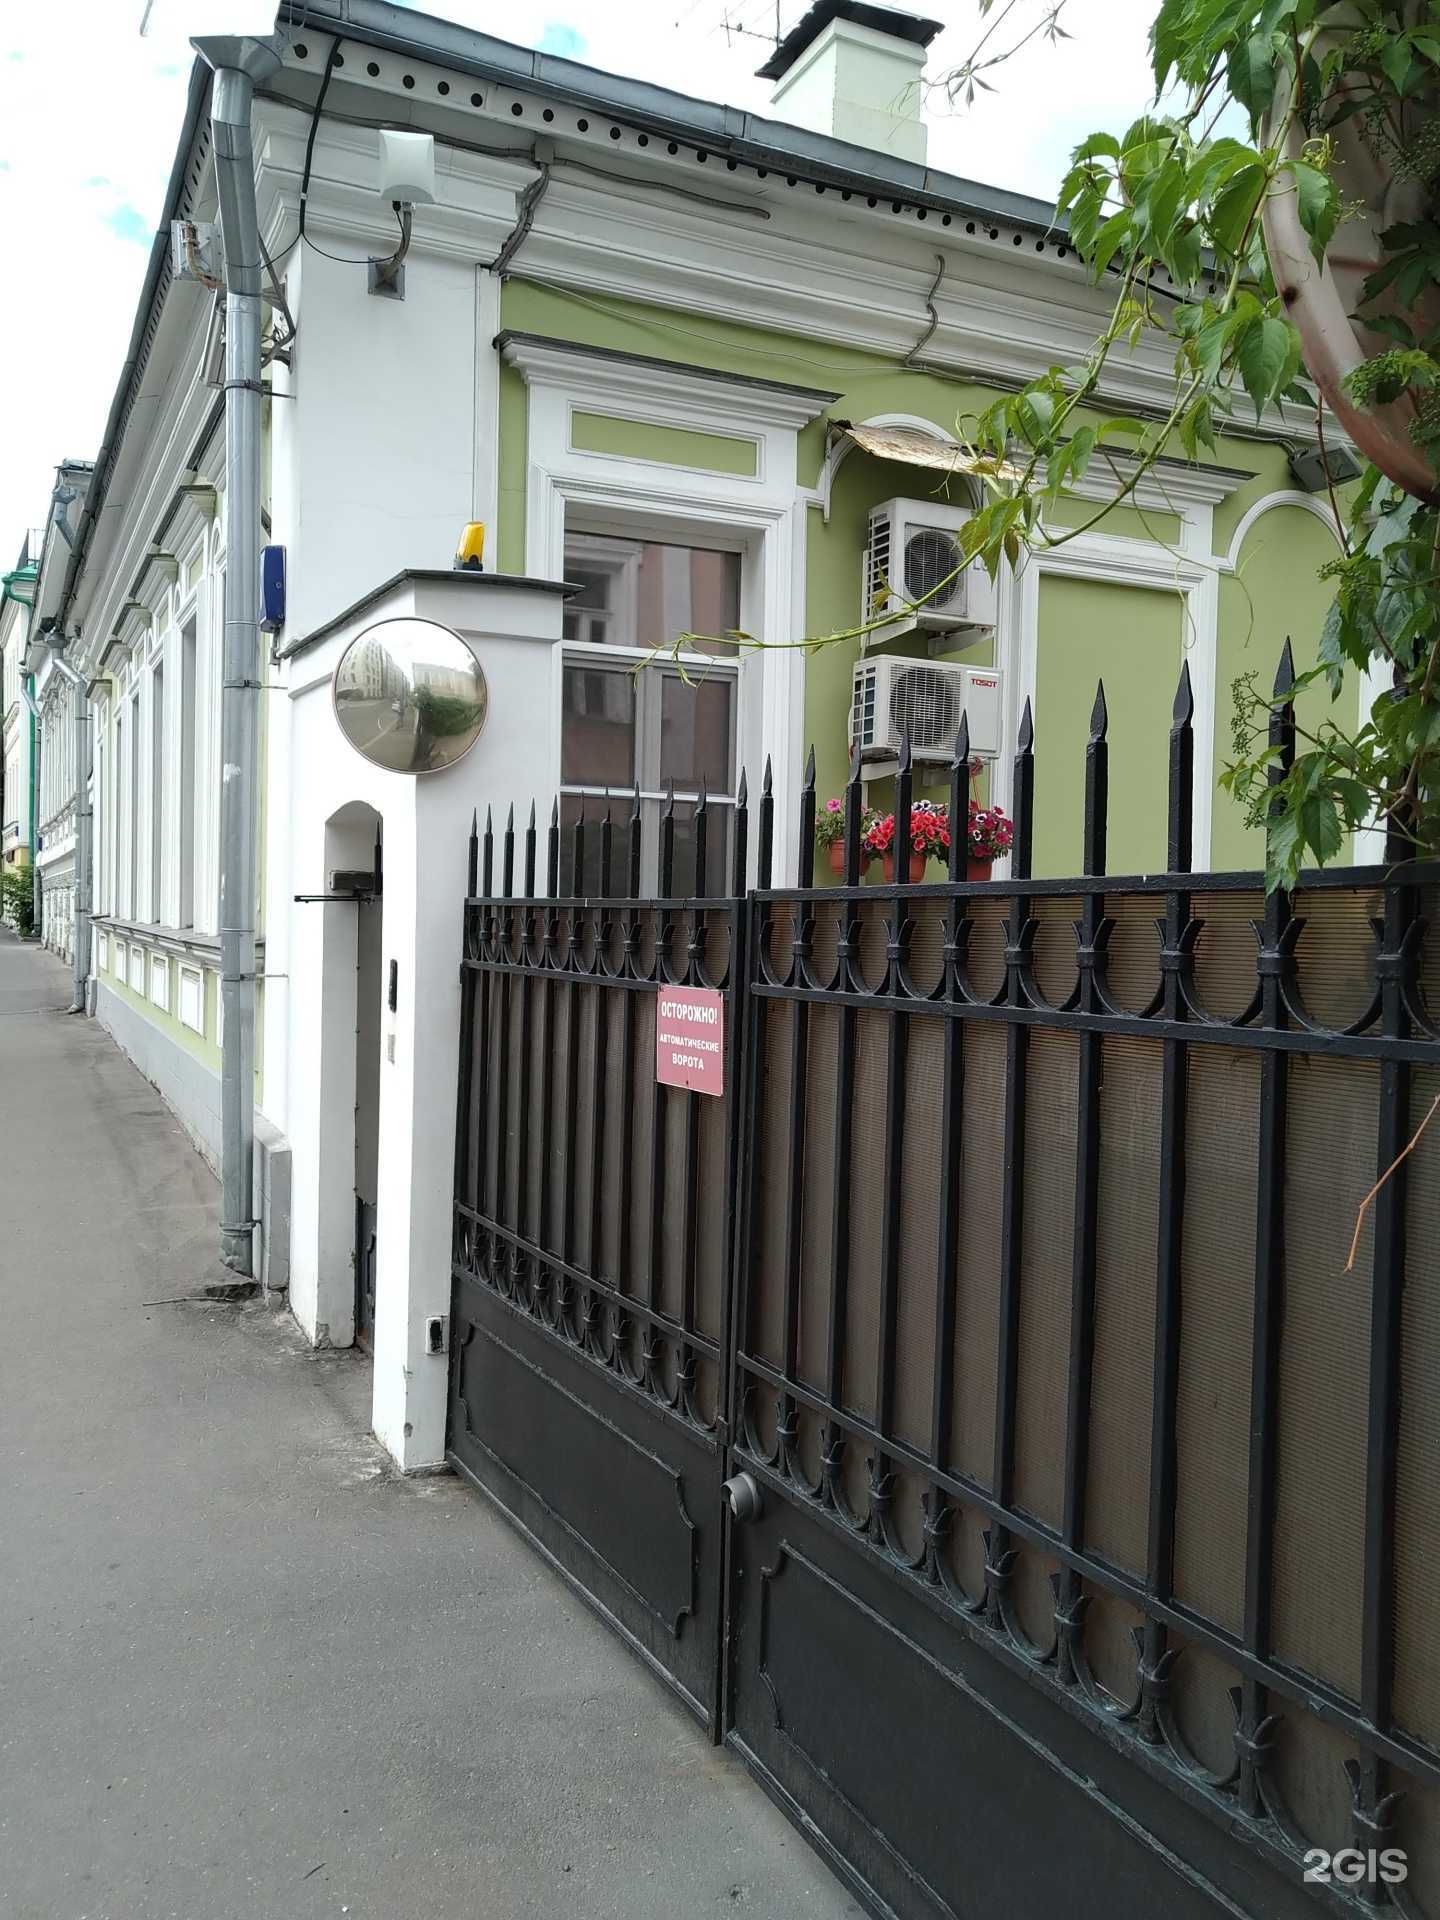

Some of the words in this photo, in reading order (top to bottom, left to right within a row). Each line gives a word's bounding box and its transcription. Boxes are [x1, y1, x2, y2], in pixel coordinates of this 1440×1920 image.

[971, 678, 998, 688] TOSOT
[661, 1001, 718, 1025] ОСТОРОЖНО!
[660, 1034, 719, 1052] АВТОМАТИЧЕСКИЕ
[672, 1053, 704, 1070] ВОРОТА
